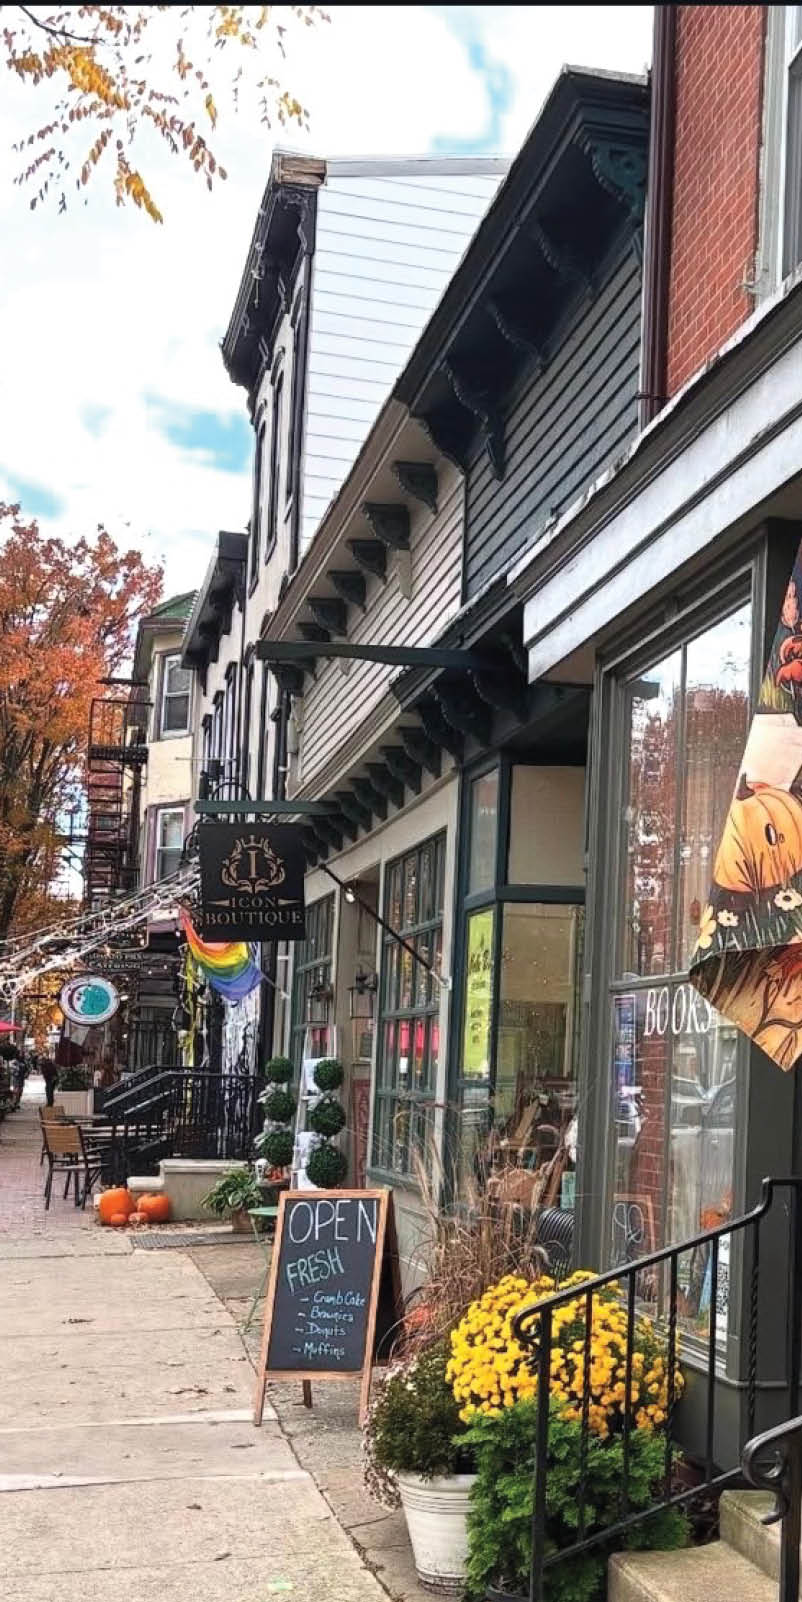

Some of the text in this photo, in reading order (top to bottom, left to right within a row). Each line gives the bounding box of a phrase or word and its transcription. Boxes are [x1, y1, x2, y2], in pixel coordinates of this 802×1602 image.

[231, 896, 276, 908] ICON
[206, 911, 304, 926] BOUTIQUE
[643, 984, 712, 1036] BOOKS
[289, 1199, 377, 1244] OPEN
[286, 1246, 345, 1294] FRESH
[304, 1321, 347, 1338] Donuts
[303, 1341, 346, 1360] Muffins
